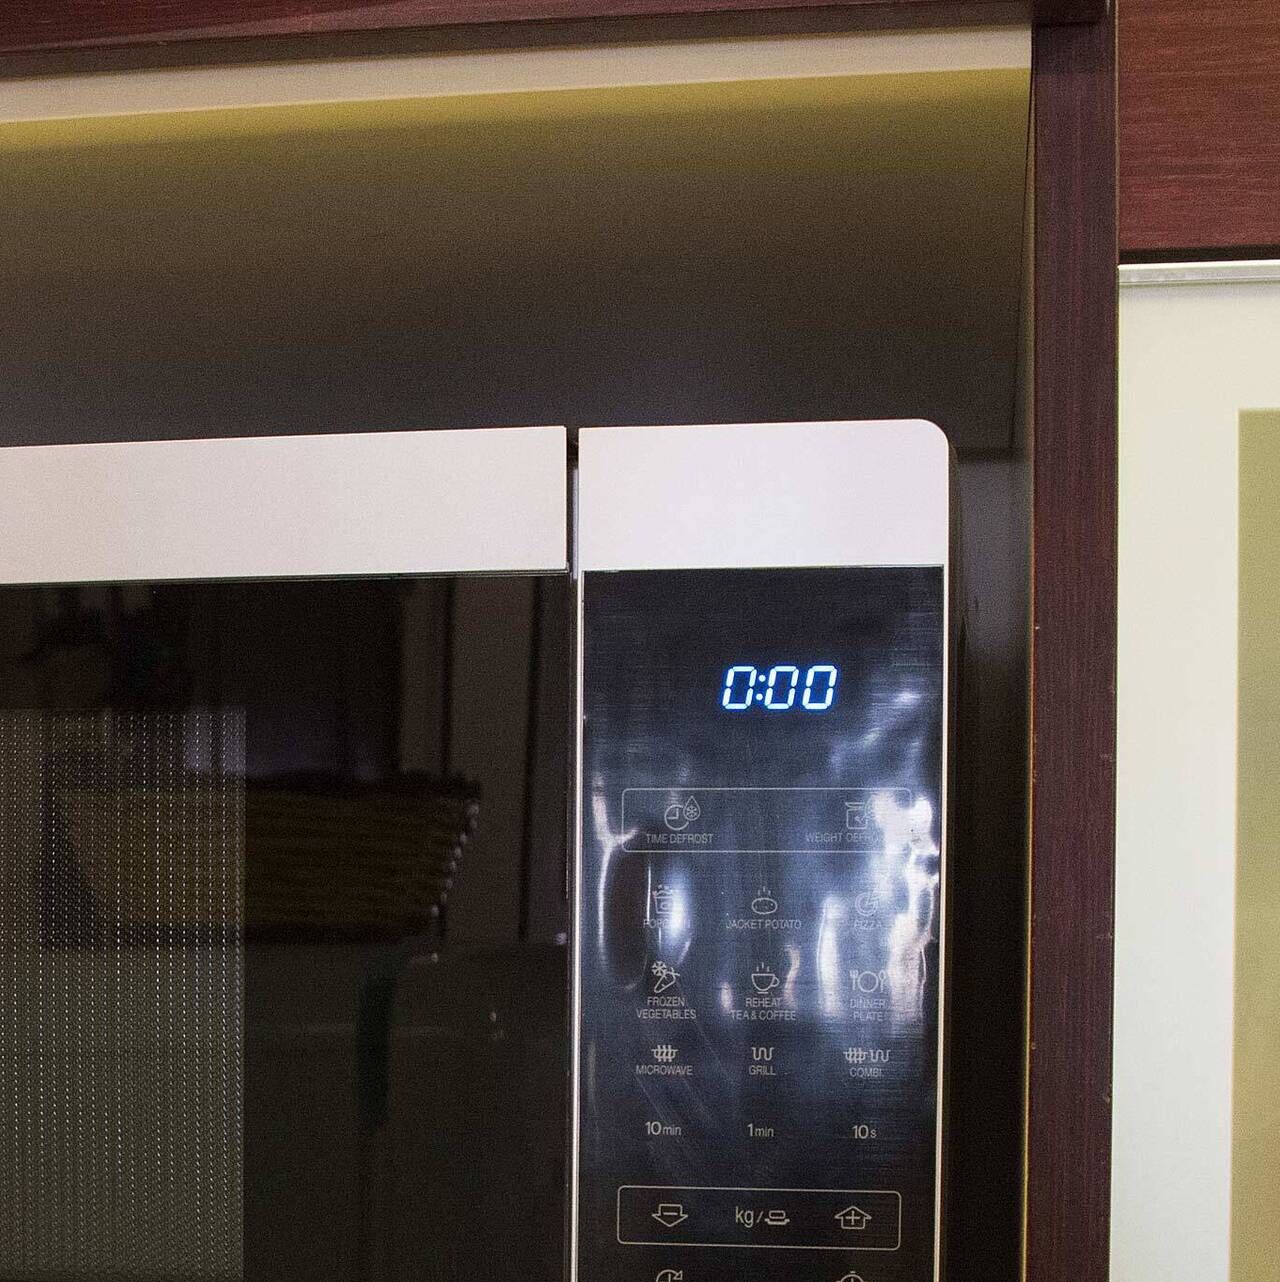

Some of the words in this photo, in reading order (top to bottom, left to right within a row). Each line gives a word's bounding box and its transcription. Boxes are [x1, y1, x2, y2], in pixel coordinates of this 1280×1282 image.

[722, 665, 838, 710] 0:00
[646, 833, 668, 844] TIME
[669, 833, 714, 844] DEFROST
[805, 831, 843, 843] WEIGHT
[726, 919, 762, 930] JACKET
[765, 919, 802, 930] POTATO
[647, 996, 686, 1007] FROZEN
[745, 997, 783, 1008] REHEAT
[850, 998, 886, 1009] DINNER
[636, 1008, 697, 1020] VEGETABLES
[731, 1009, 751, 1020] TEA
[758, 1010, 796, 1021] COFFEE
[853, 1011, 883, 1022] PLATE
[636, 1064, 693, 1076] MICROWAVE
[748, 1064, 777, 1076] GRILL
